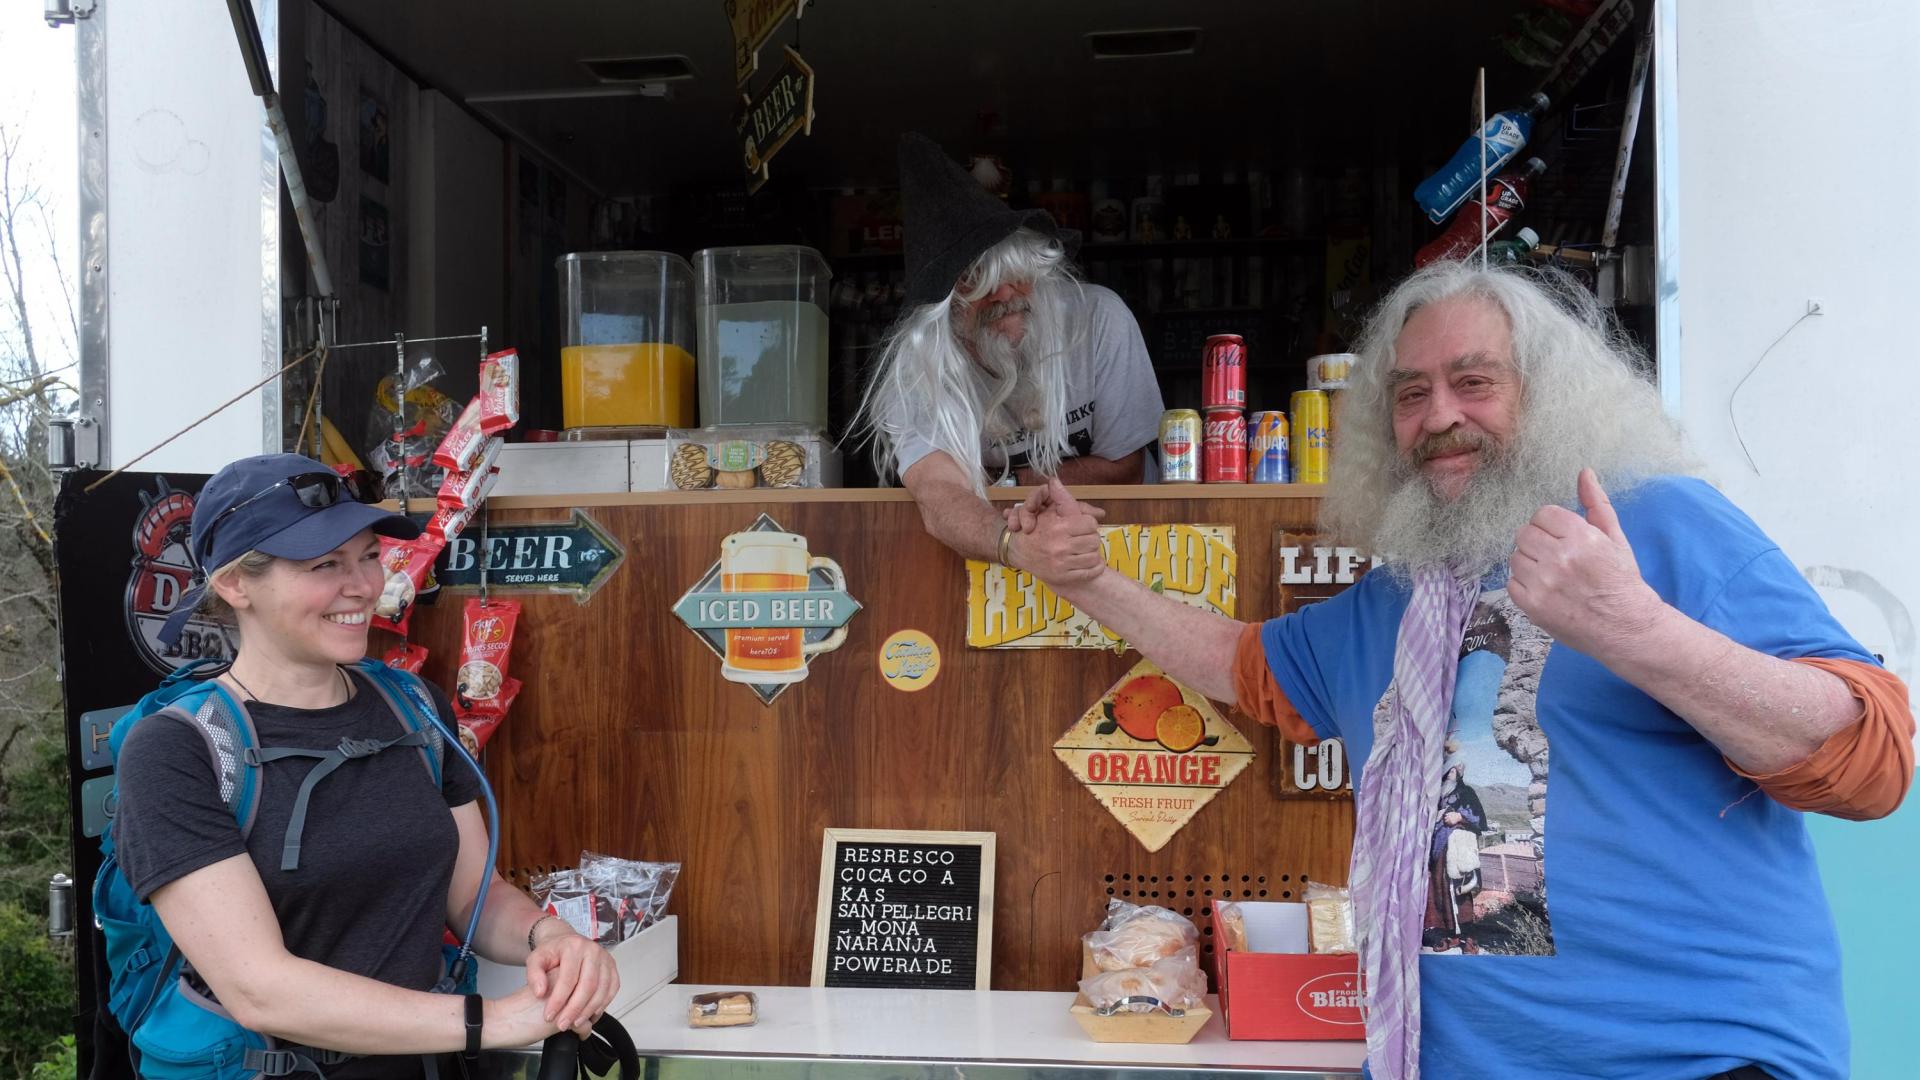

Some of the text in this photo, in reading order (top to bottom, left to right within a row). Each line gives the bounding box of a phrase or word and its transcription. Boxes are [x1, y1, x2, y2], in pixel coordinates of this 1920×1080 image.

[753, 74, 796, 144] BEER
[445, 535, 573, 572] BEER
[505, 573, 560, 583] SERVED HERE
[965, 523, 1238, 648] LEMNADE
[699, 599, 835, 621] ICED BEER
[1087, 750, 1222, 786] ORANGE
[1112, 796, 1195, 810] FRESH FRUIT
[844, 847, 955, 866] RESRESCO
[840, 886, 885, 903] KAS
[838, 903, 972, 921] SAN PELLEGRI
[860, 919, 920, 936] MONA
